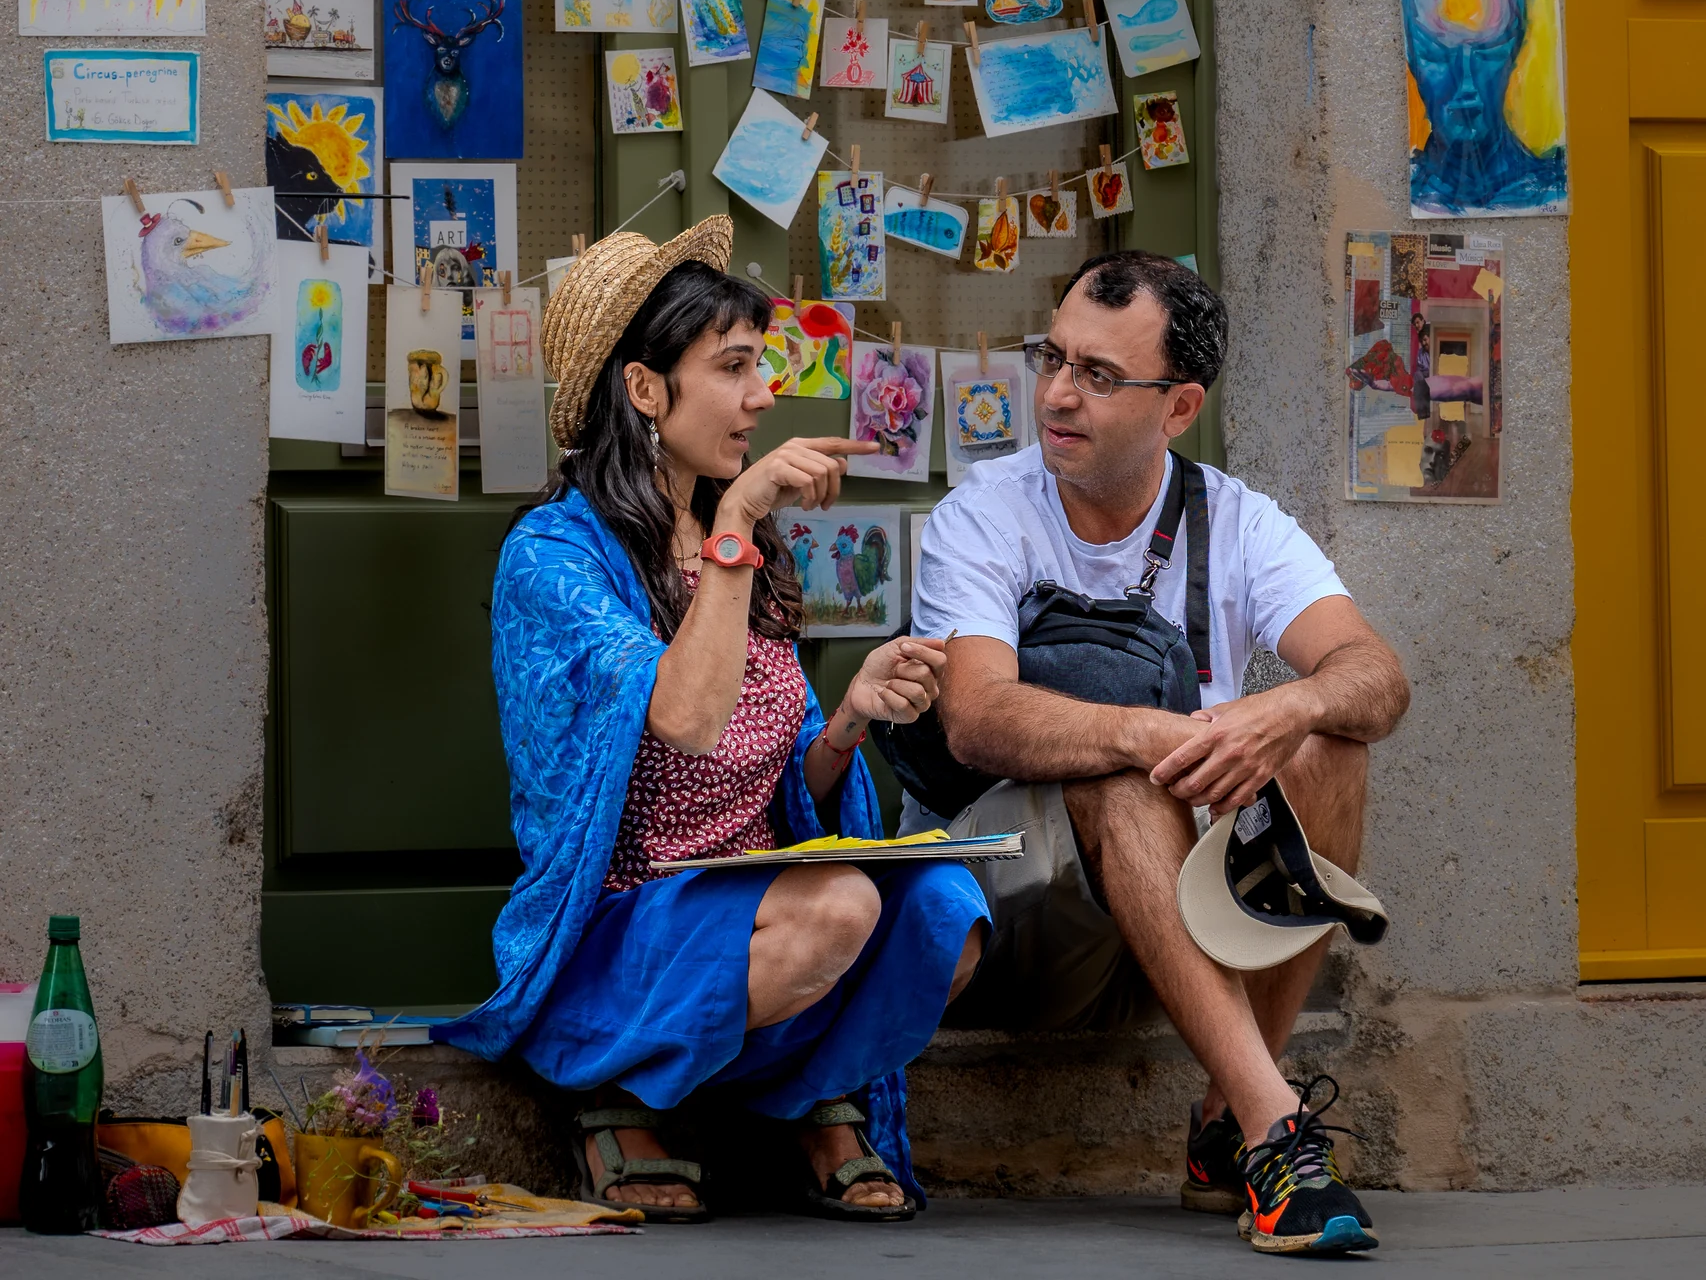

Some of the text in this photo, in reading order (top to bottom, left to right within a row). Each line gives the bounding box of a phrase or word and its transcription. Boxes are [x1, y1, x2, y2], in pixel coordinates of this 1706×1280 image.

[437, 230, 465, 245] ART
[1430, 243, 1452, 253] Music
[1379, 300, 1398, 309] GET
